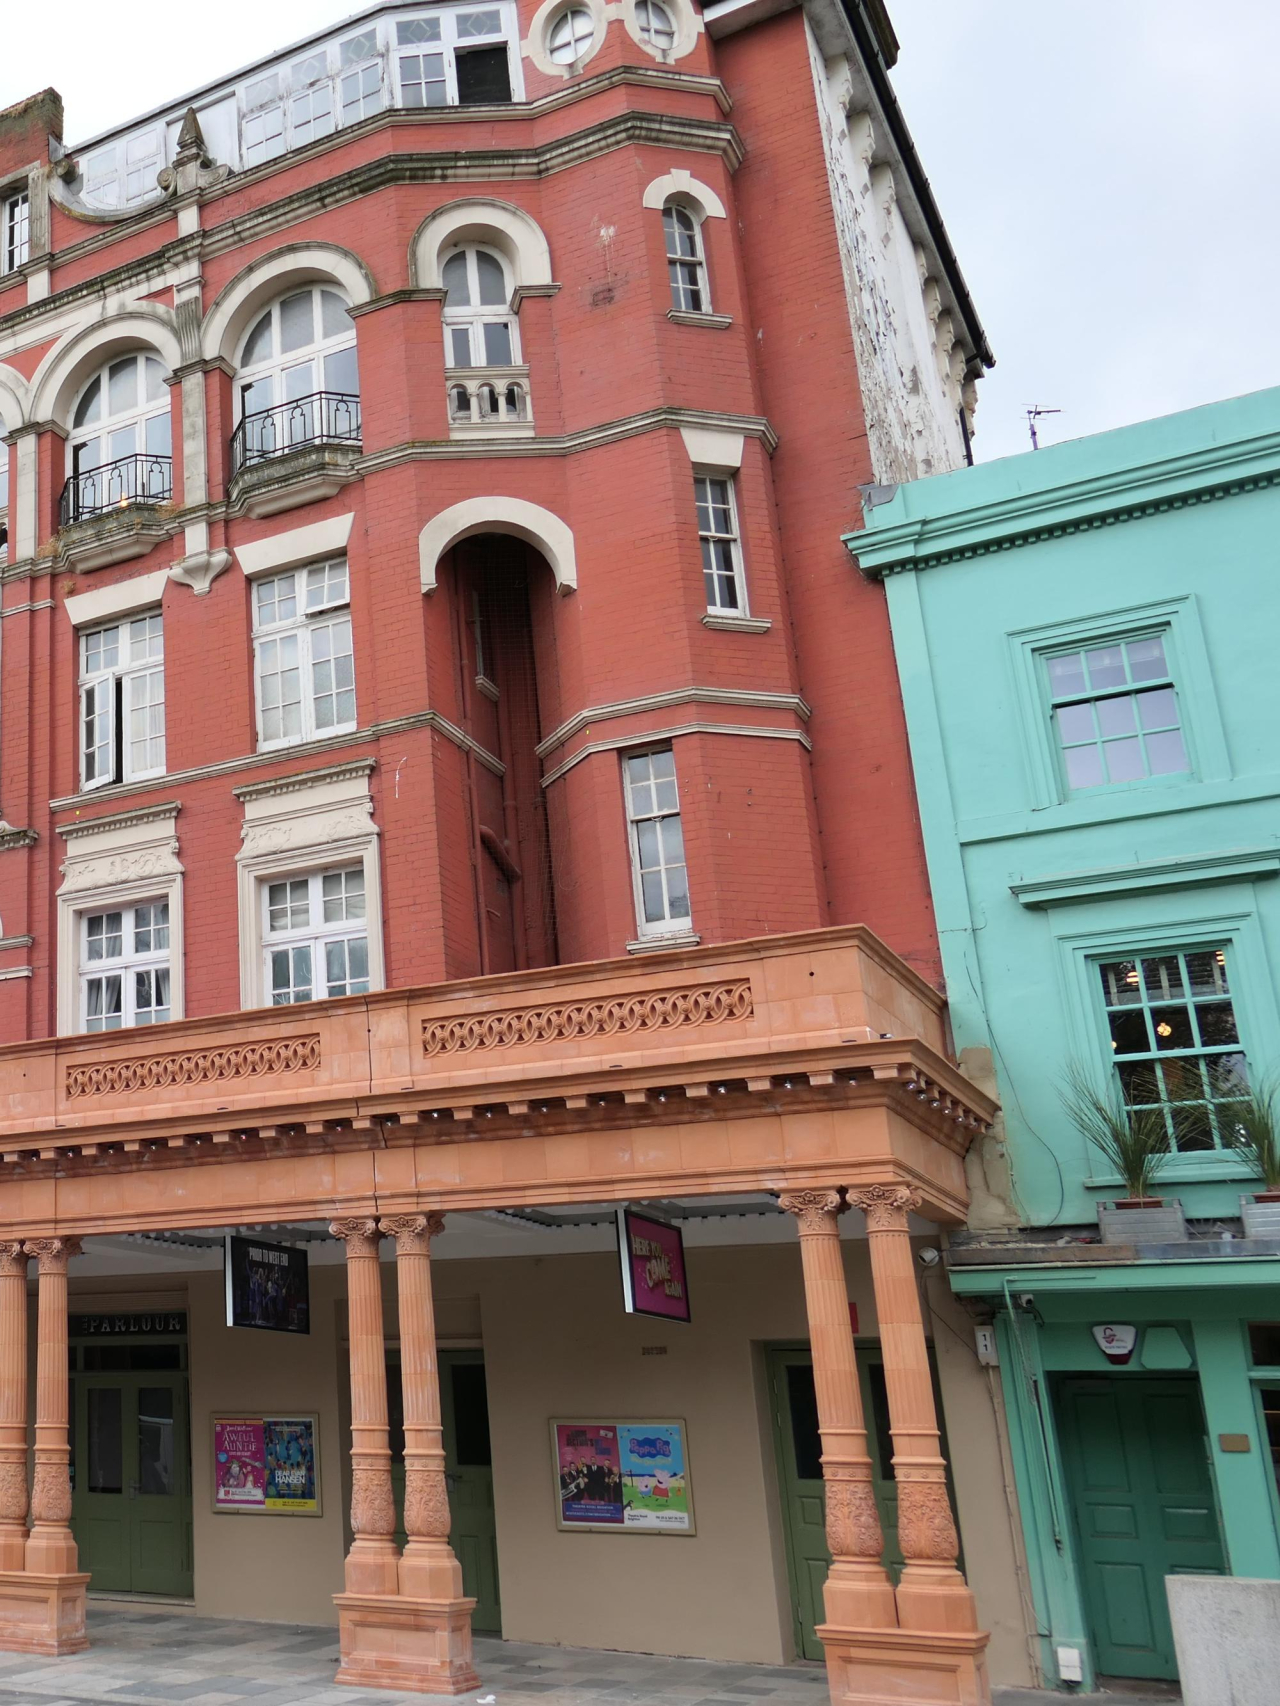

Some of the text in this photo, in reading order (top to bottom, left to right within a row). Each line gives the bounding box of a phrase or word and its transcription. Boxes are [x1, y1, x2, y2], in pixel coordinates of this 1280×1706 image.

[89, 1315, 181, 1333] PARLOUR
[223, 1431, 256, 1441] AWFUL
[631, 1439, 670, 1456] Peppa Pig
[275, 1475, 306, 1484] HANSEN
